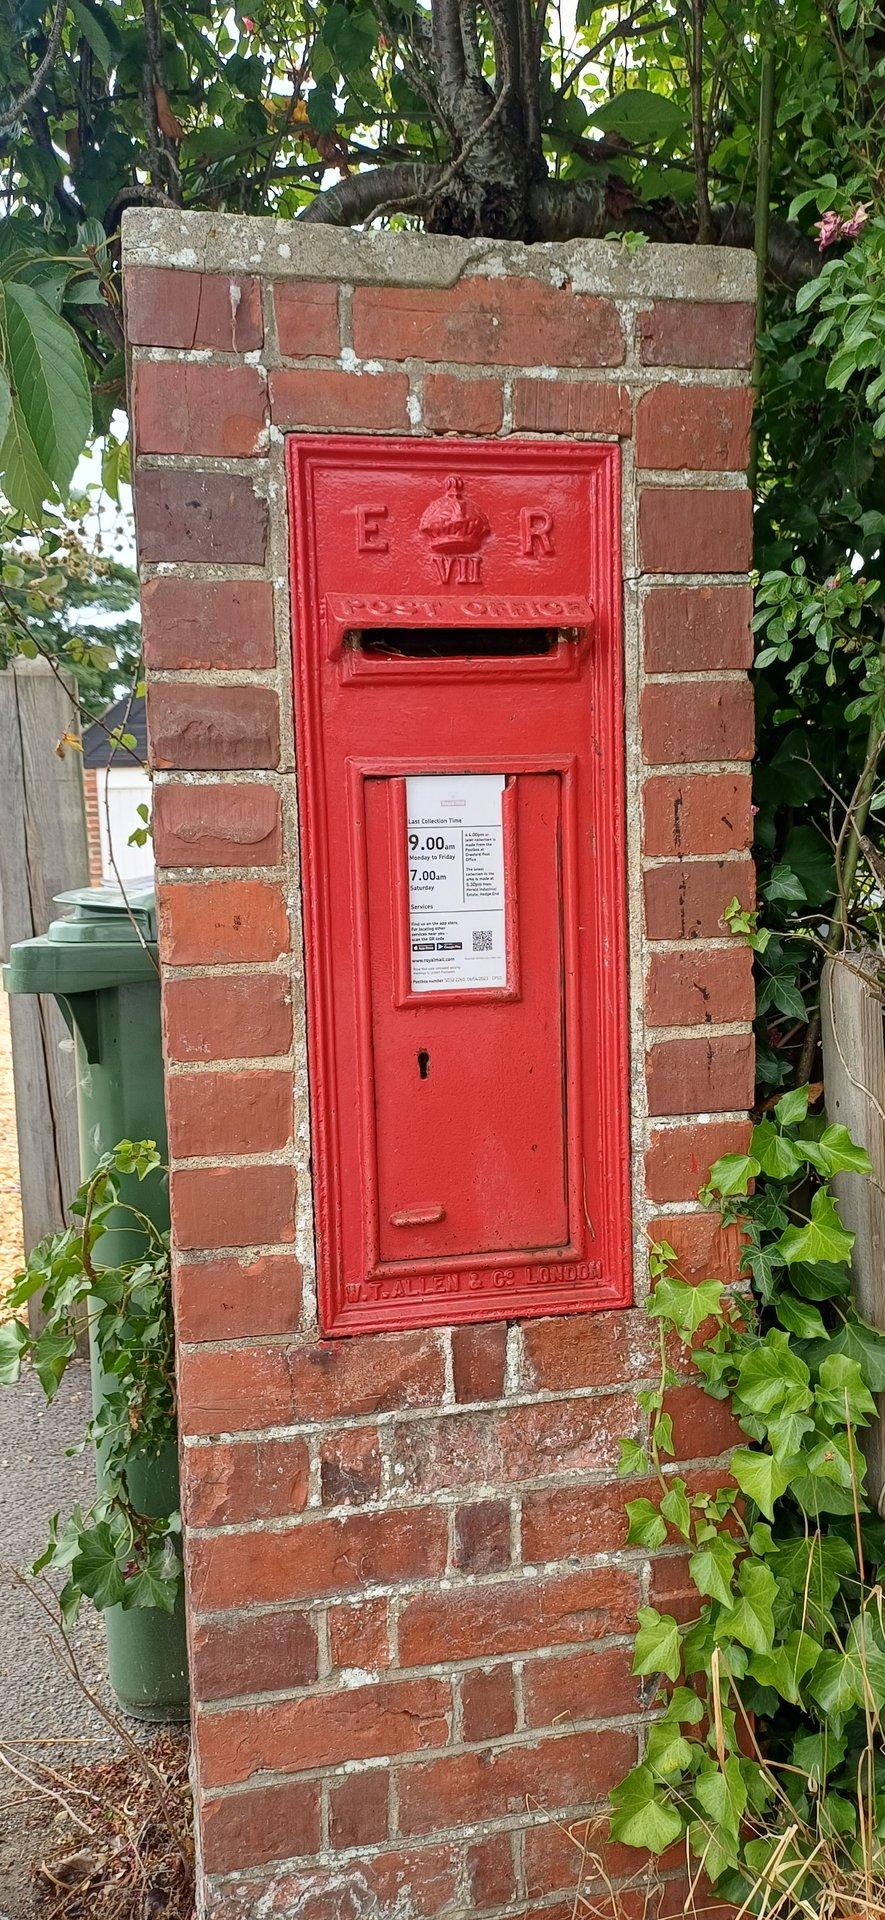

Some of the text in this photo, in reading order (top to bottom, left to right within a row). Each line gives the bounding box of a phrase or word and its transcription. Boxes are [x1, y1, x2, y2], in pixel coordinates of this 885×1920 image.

[356, 504, 555, 555] E R
[432, 556, 483, 585] VII
[344, 600, 586, 617] POST OFFICE
[408, 834, 455, 850] 9.00am
[410, 869, 446, 881] 7.00am
[470, 1272, 485, 1290] &
[525, 1261, 603, 1285] LONDON
